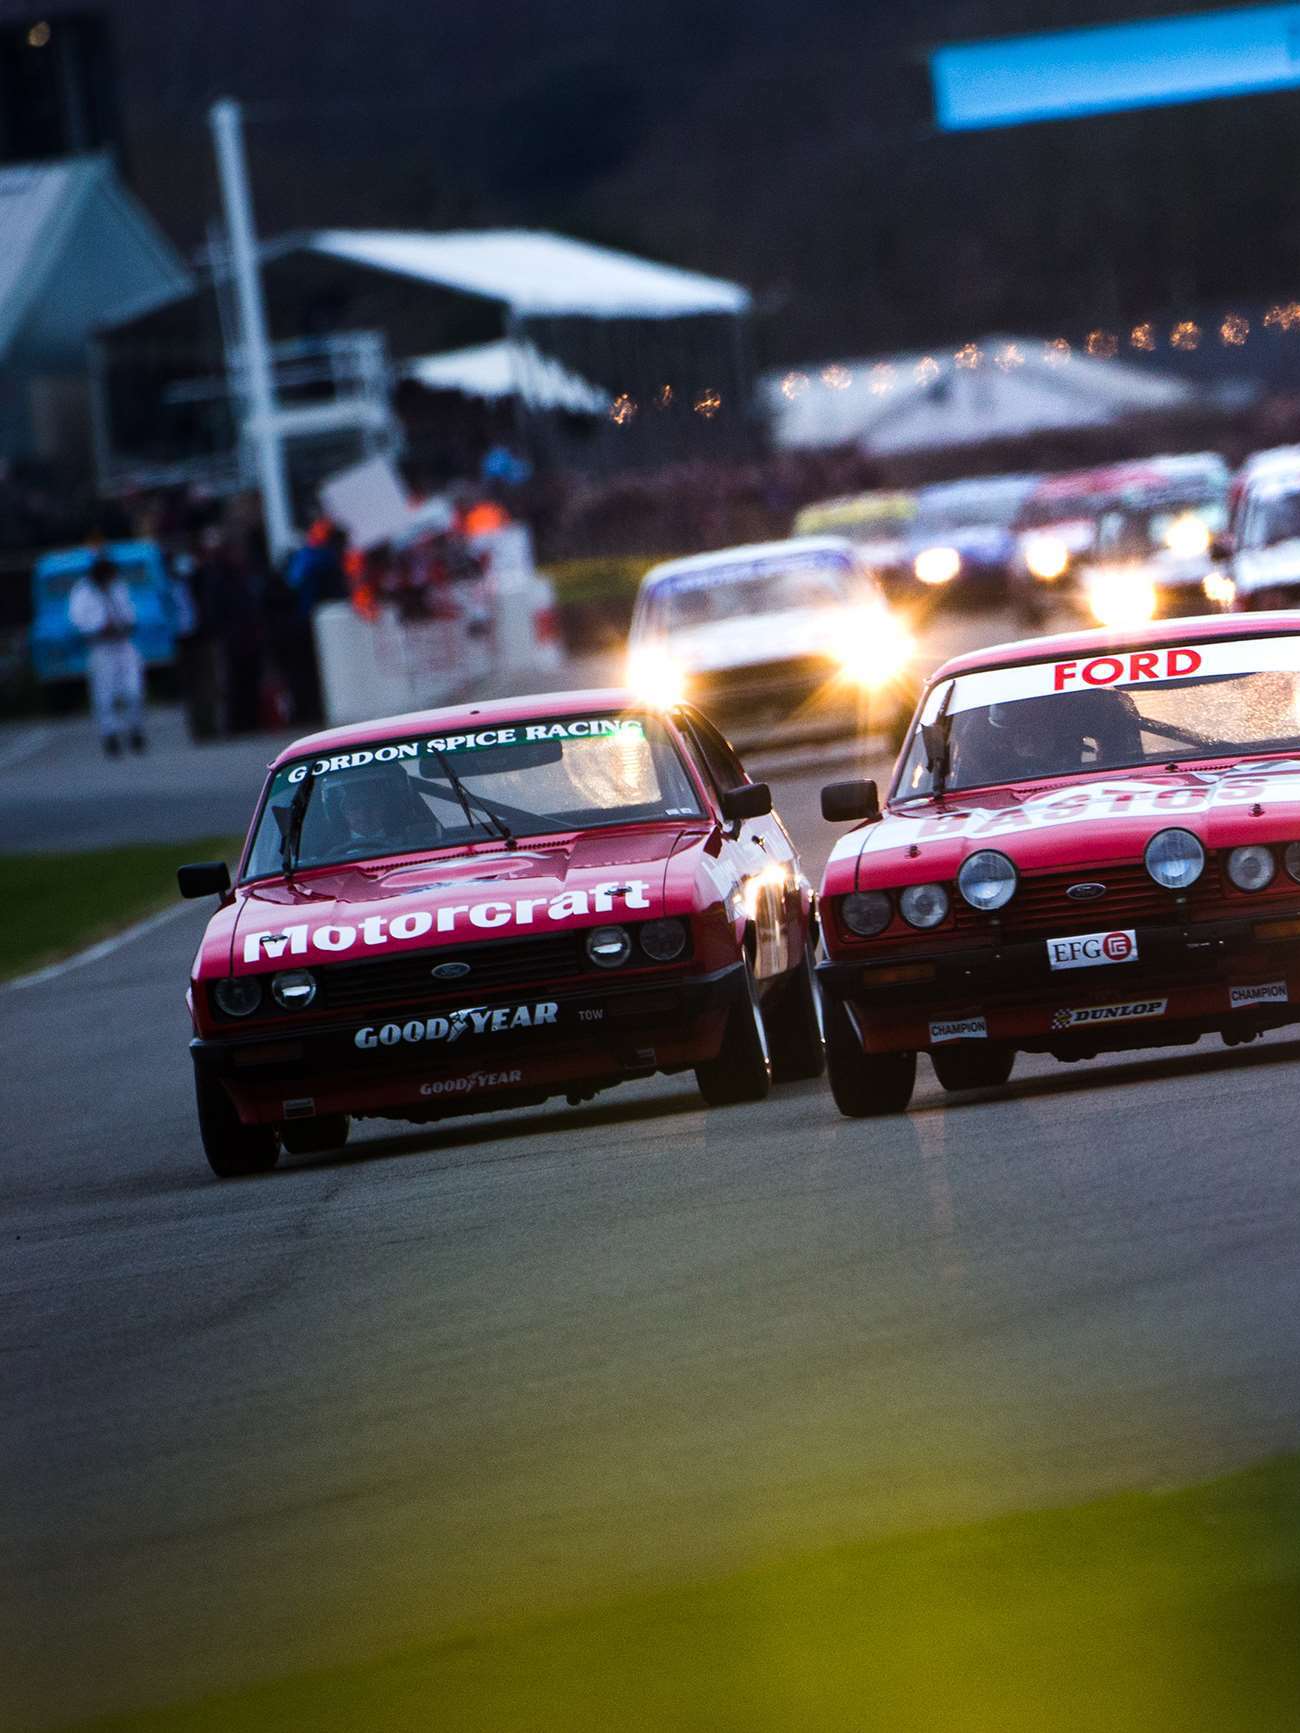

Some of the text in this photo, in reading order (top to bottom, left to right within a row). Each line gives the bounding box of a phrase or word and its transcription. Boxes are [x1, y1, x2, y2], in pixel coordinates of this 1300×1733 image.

[1054, 649, 1202, 691] FORD
[288, 720, 643, 783] GORDON SPICE RACING
[243, 879, 651, 963] Motorcraft
[1054, 939, 1101, 963] EFG
[1232, 985, 1287, 1001] CHAMPION
[578, 1009, 604, 1022] TOW
[1074, 1001, 1163, 1022] DUNLOP
[932, 1021, 985, 1036] CHAMPION
